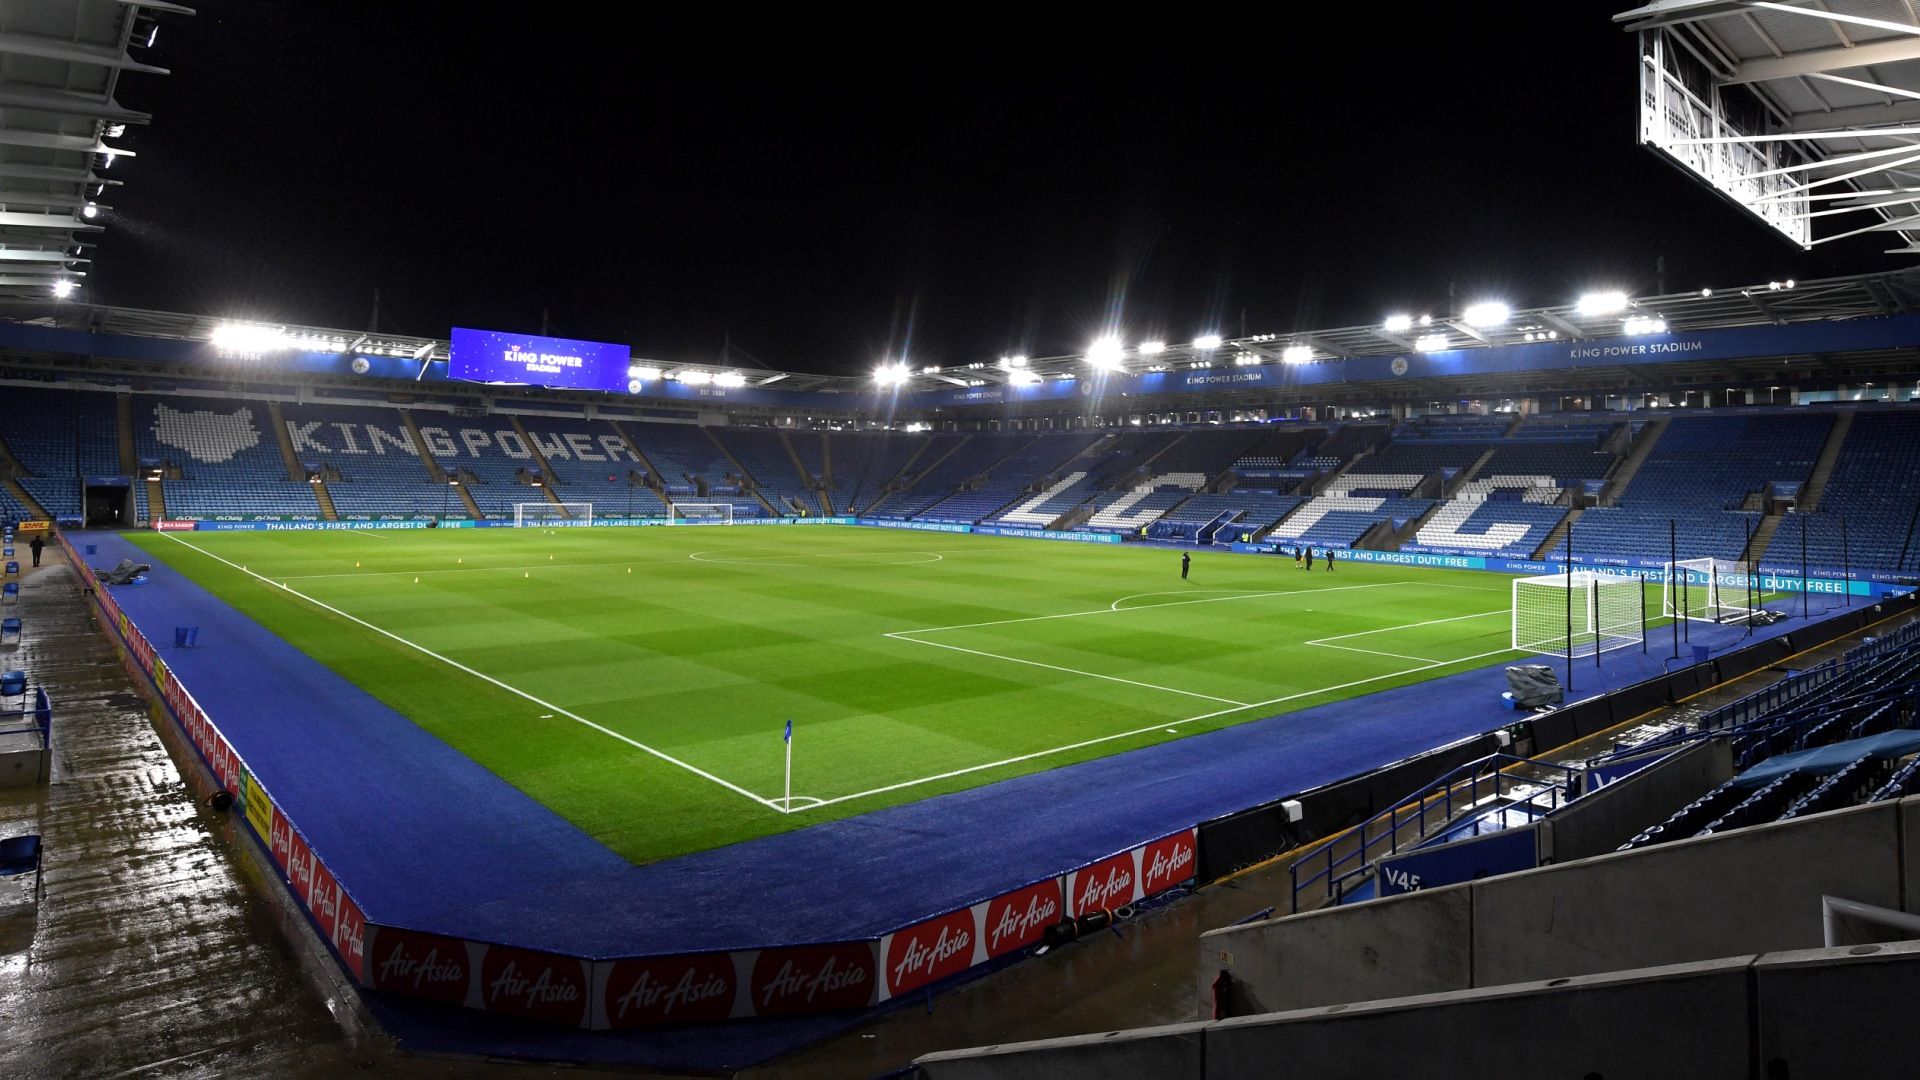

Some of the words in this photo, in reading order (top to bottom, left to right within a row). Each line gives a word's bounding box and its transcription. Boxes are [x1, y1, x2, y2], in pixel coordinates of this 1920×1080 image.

[503, 350, 537, 363] KING
[540, 353, 582, 367] POWER
[1570, 348, 1600, 359] KING
[1604, 345, 1646, 356] POWER
[1650, 341, 1702, 353] STADIUM
[1187, 376, 1205, 384] KING
[1233, 374, 1262, 382] STADIUM
[1000, 529, 1029, 537] THAILAND'S
[1057, 532, 1081, 540] LARGEST
[1333, 550, 1352, 559] IRST
[1376, 553, 1416, 564] LARGEST
[1418, 556, 1443, 565] DUTY
[1445, 558, 1468, 567] FREE
[1631, 569, 1662, 580] FIRST
[1700, 573, 1758, 587] LARGEST
[1765, 577, 1802, 590] DUTY
[1807, 581, 1842, 593] FREE
[272, 819, 288, 853] AirAsia
[291, 844, 309, 882] AirAsia
[1146, 842, 1192, 888] AirAsia
[314, 874, 335, 918] AirAsia
[1078, 866, 1131, 915] AirAsia
[340, 908, 364, 957] AirAsia
[992, 894, 1056, 949] AirAsia
[381, 941, 462, 988] AirAsia
[895, 926, 969, 987] AirAsia
[491, 960, 578, 1009] AirAsia
[617, 966, 727, 1019] AirAsia
[762, 955, 866, 1006] AirAsia
